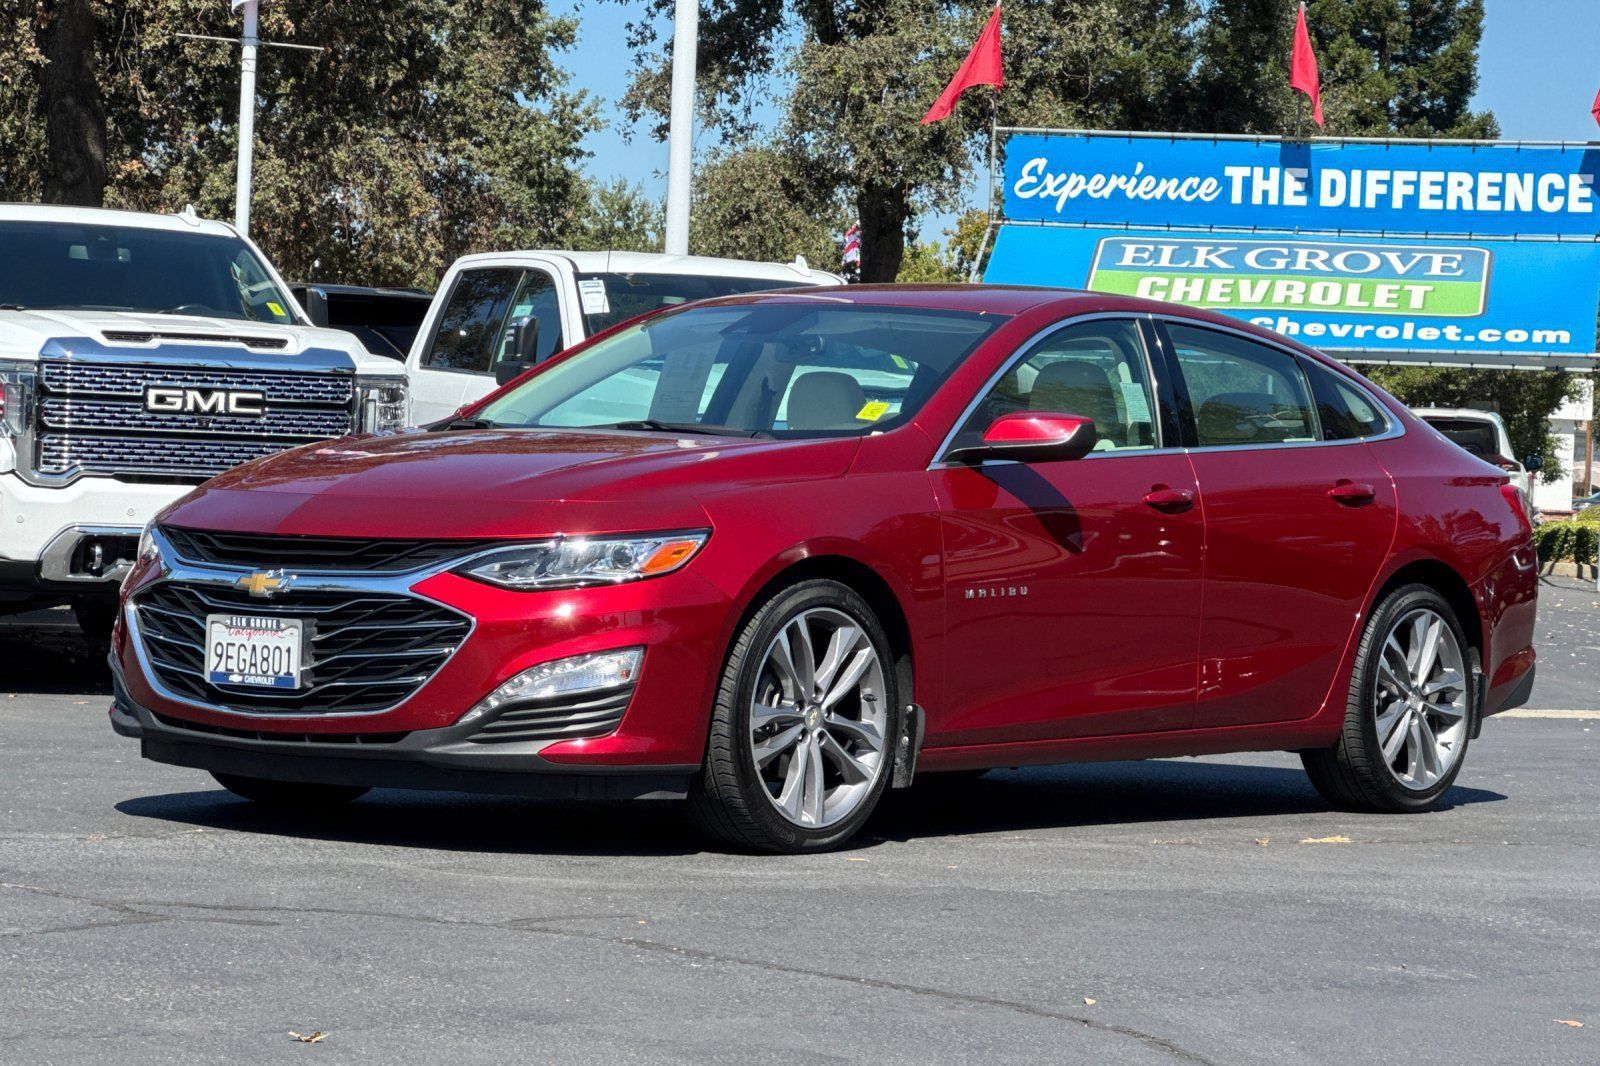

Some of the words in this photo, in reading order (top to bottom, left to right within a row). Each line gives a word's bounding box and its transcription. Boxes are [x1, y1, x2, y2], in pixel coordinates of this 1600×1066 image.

[1014, 157, 1222, 213] Experience
[1224, 166, 1309, 206] THE
[1319, 168, 1594, 213] DIFFERENCE
[1114, 243, 1239, 270] ELK
[1244, 246, 1465, 277] GROVE
[1136, 275, 1435, 309] CHEVROLET
[147, 388, 263, 414] GMC
[965, 586, 1028, 599] MALIBU
[232, 616, 247, 627] ELK
[250, 618, 277, 629] GROVE
[214, 641, 294, 676] 9EGA801
[244, 675, 275, 686] CHEVROLET
